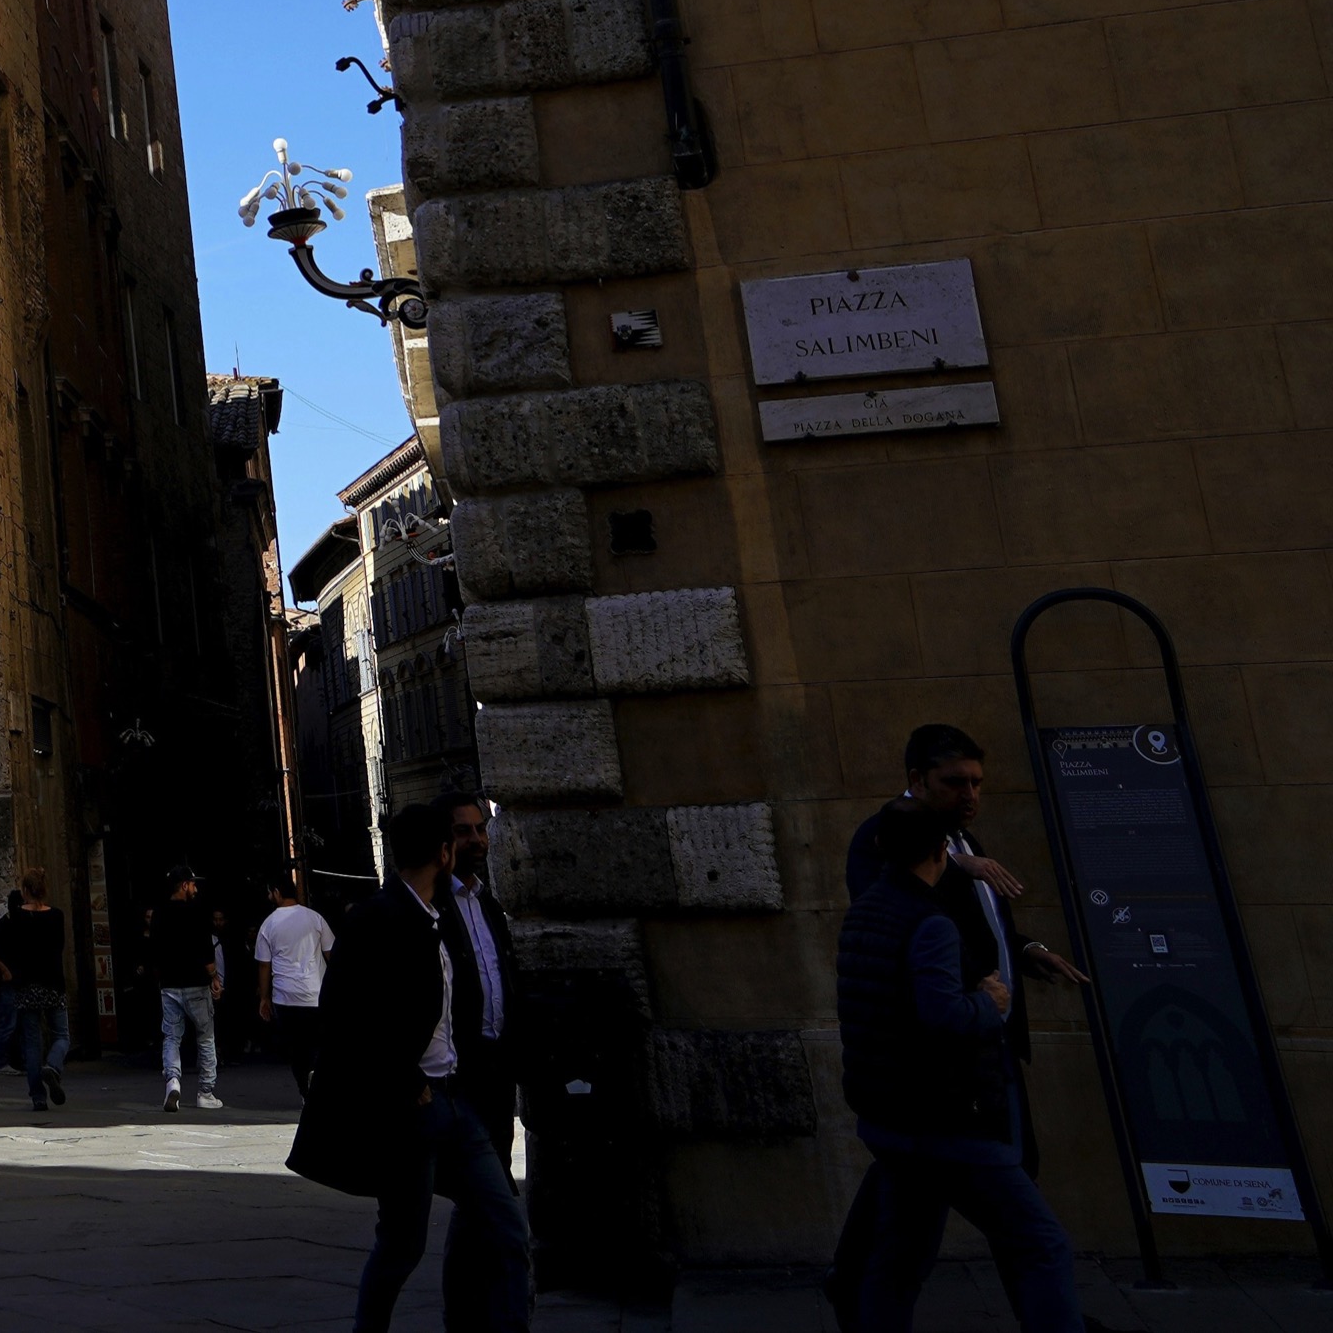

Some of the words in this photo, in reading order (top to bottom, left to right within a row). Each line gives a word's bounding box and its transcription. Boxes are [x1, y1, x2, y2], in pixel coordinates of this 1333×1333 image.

[810, 291, 907, 315] PIAZZA
[795, 328, 939, 357] SALIMBENI
[793, 420, 842, 433] PIAZZA
[852, 416, 893, 428] DELLA
[903, 410, 965, 424] DOGANA
[1059, 760, 1093, 769] PIAZZA
[1061, 768, 1109, 777] SALIMBENI
[1192, 1177, 1232, 1187] COMUNE
[1234, 1179, 1243, 1187] DI
[1244, 1180, 1272, 1189] SIENA
